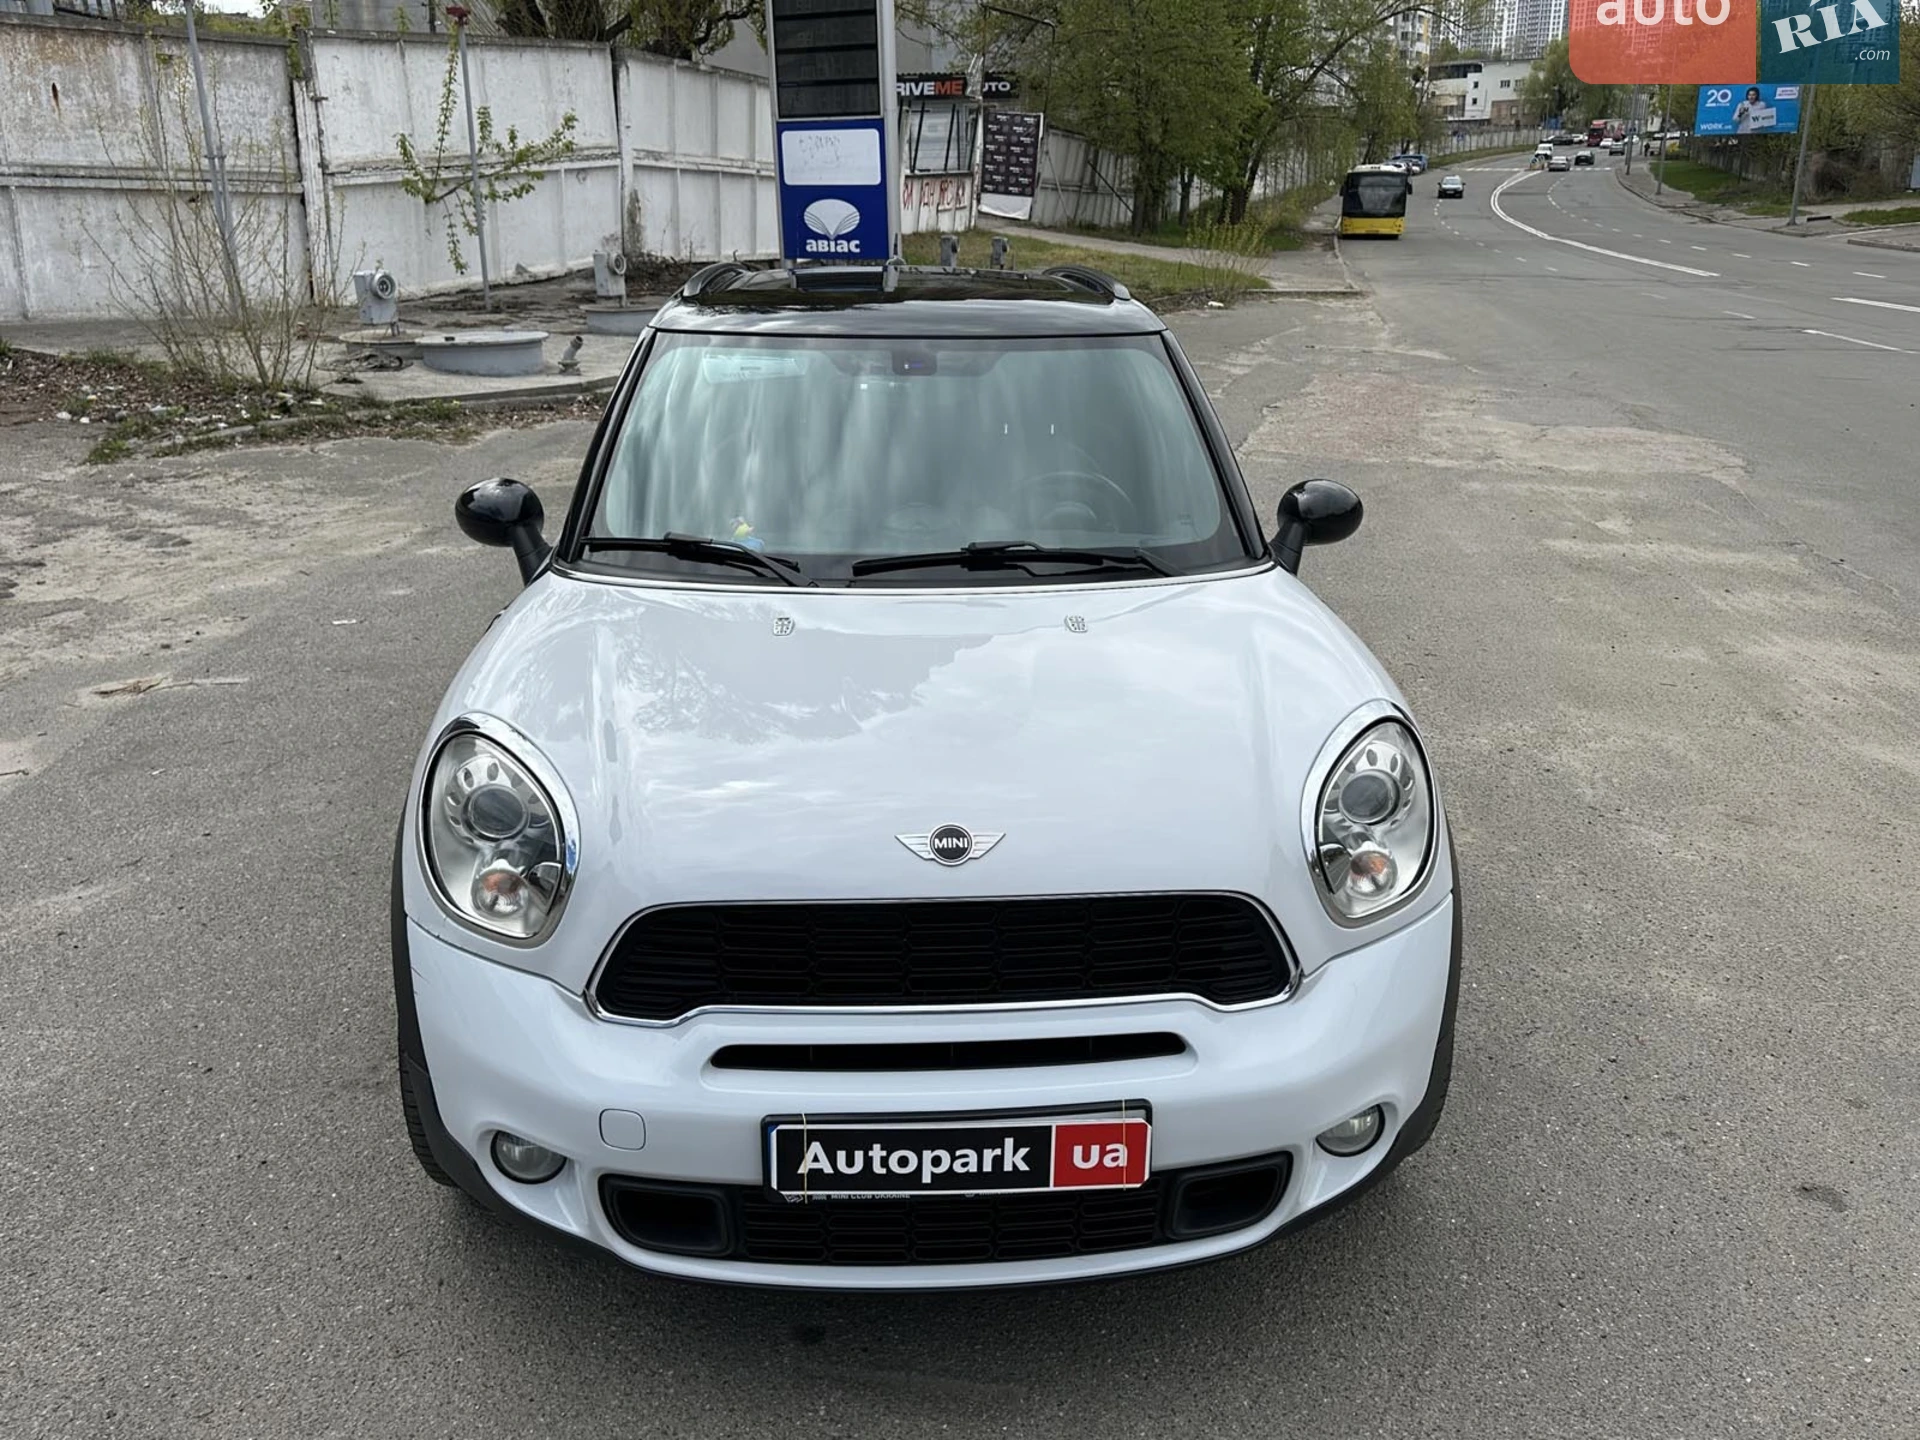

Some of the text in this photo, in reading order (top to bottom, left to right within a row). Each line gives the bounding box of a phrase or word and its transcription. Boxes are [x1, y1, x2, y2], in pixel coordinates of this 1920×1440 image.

[896, 80, 1011, 96] RIVEME UTO
[1706, 89, 1732, 104] 20
[934, 837, 968, 849] MINI
[797, 1137, 1129, 1184] Autopark ua
